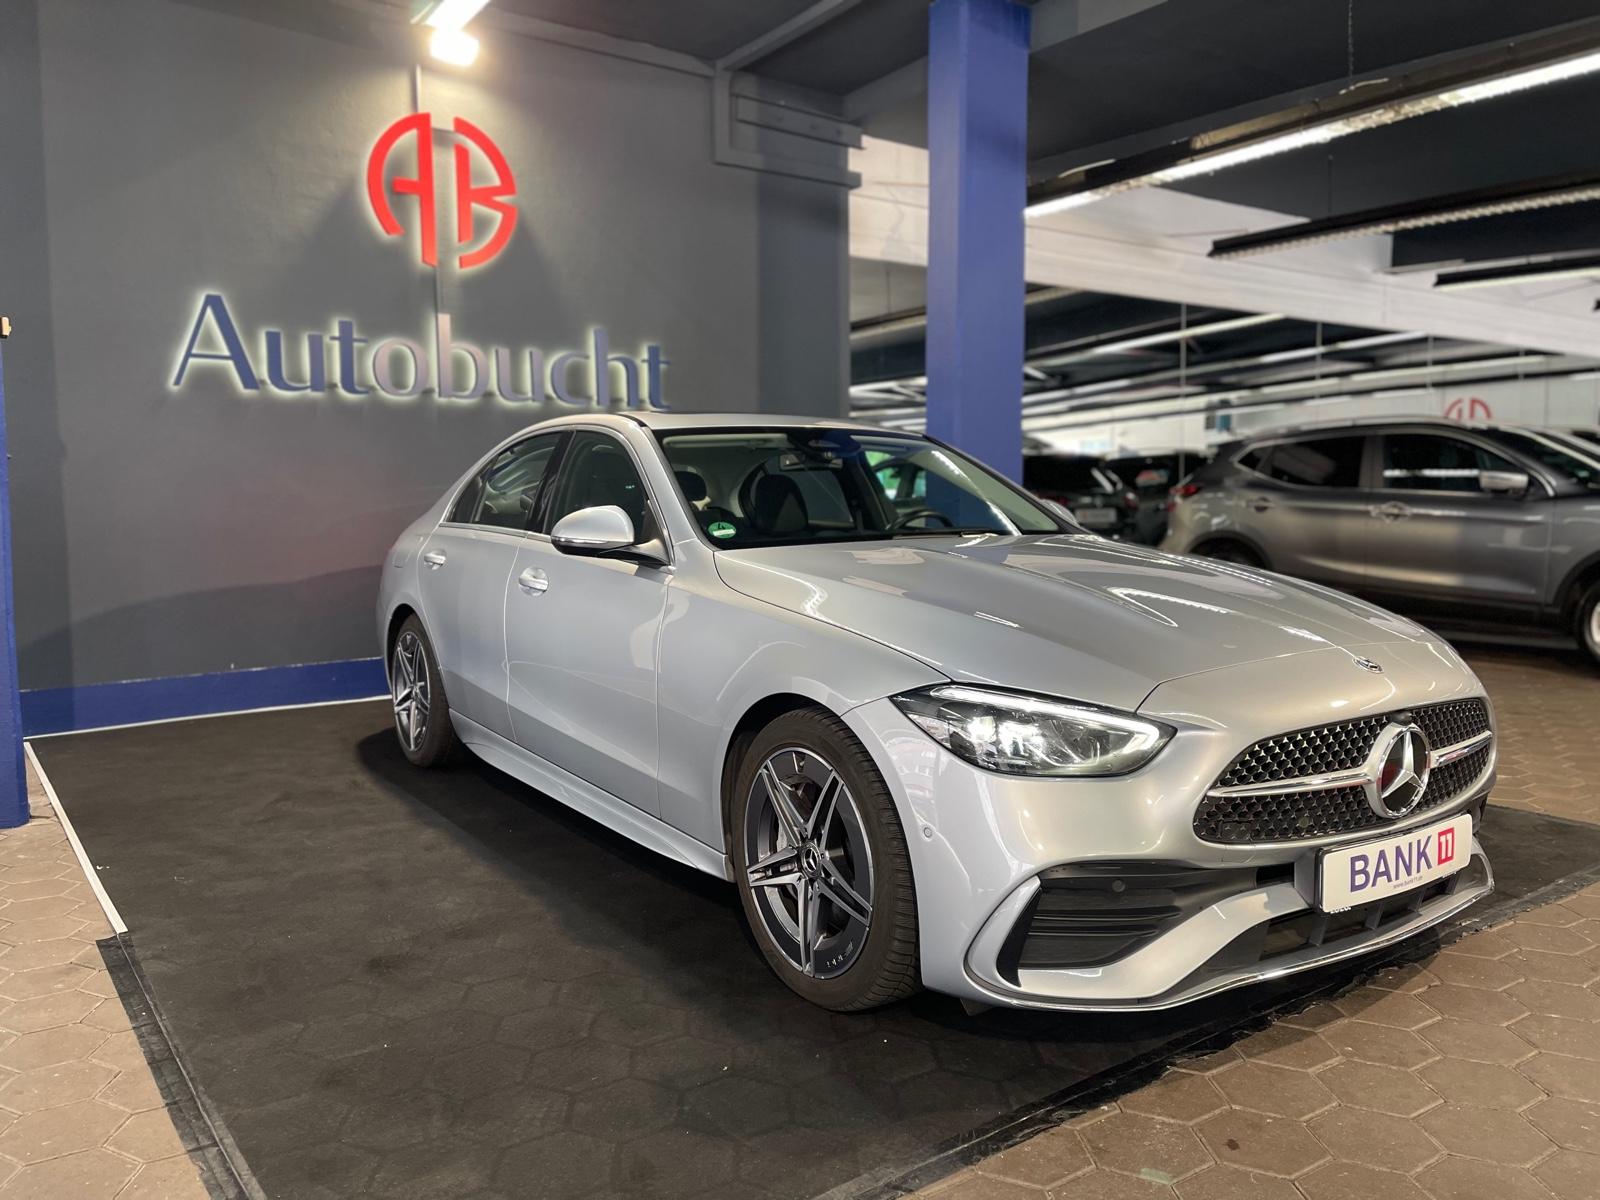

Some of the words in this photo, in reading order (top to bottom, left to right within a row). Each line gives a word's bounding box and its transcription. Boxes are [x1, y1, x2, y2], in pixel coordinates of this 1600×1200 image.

[366, 112, 518, 269] AB
[172, 292, 671, 410] Autobucht
[1350, 834, 1432, 893] BANK
[1438, 830, 1454, 861] 11
